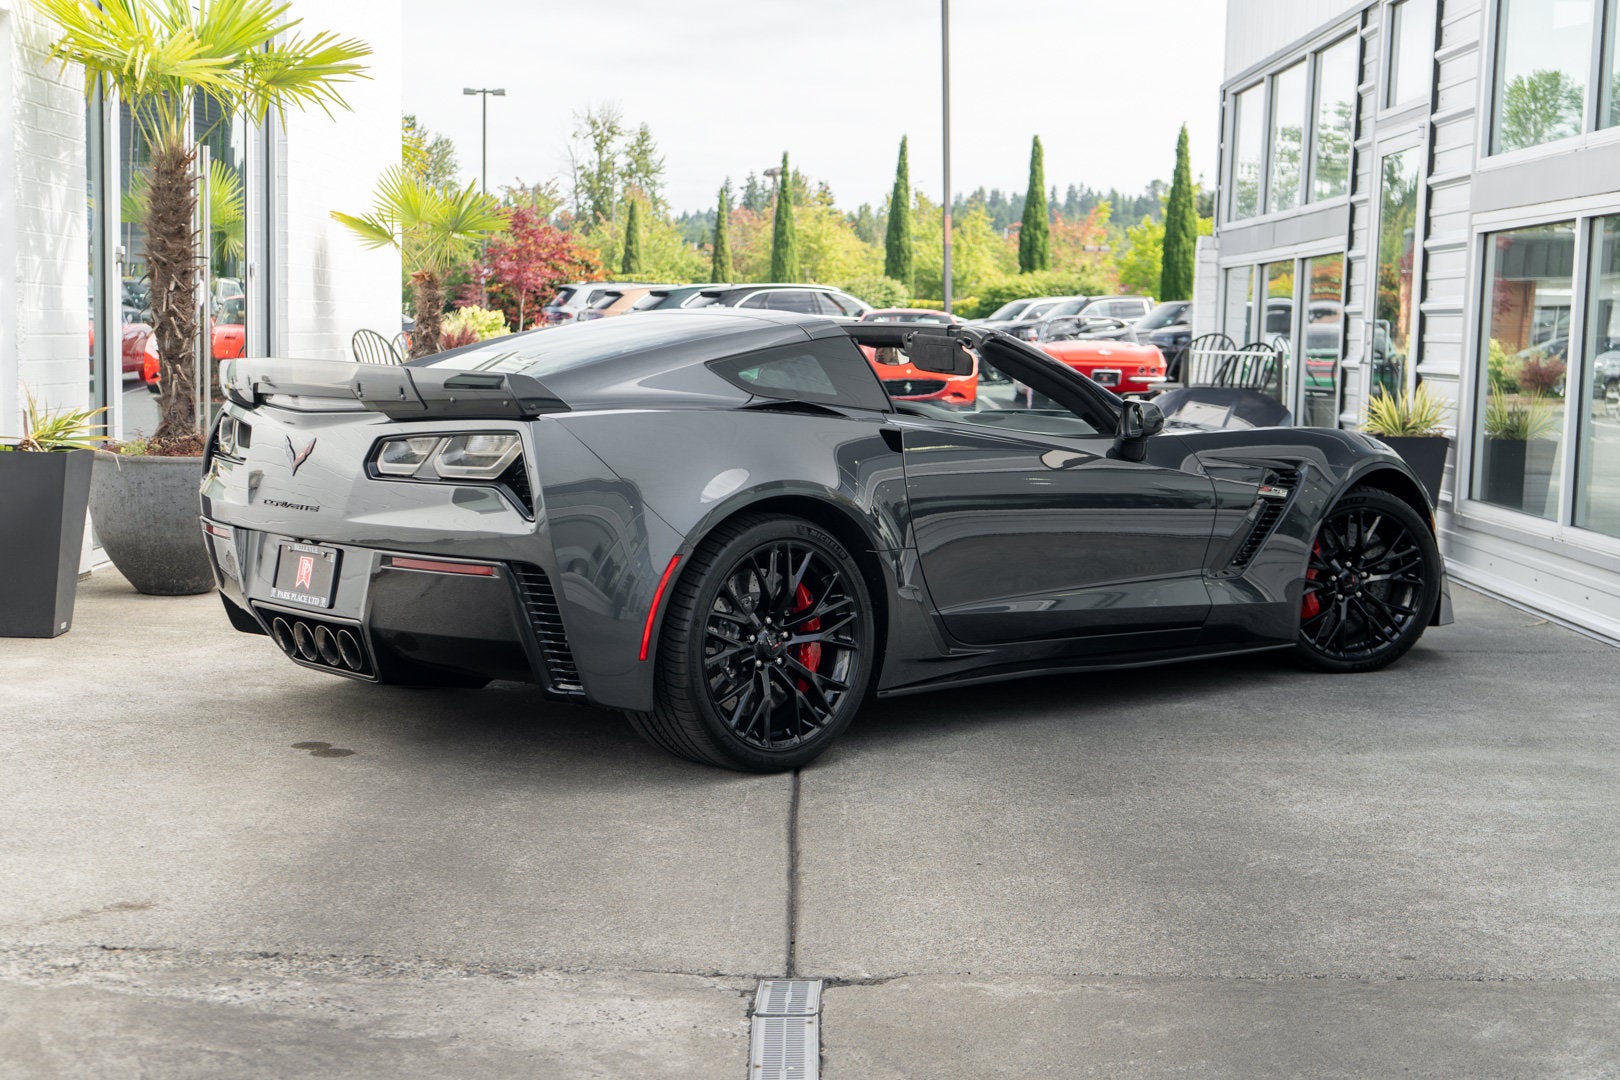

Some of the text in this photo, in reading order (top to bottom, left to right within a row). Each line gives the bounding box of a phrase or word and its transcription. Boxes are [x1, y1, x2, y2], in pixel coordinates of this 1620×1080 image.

[808, 529, 848, 560] MICHELIN
[277, 590, 320, 605] PARK PLACE LTD
